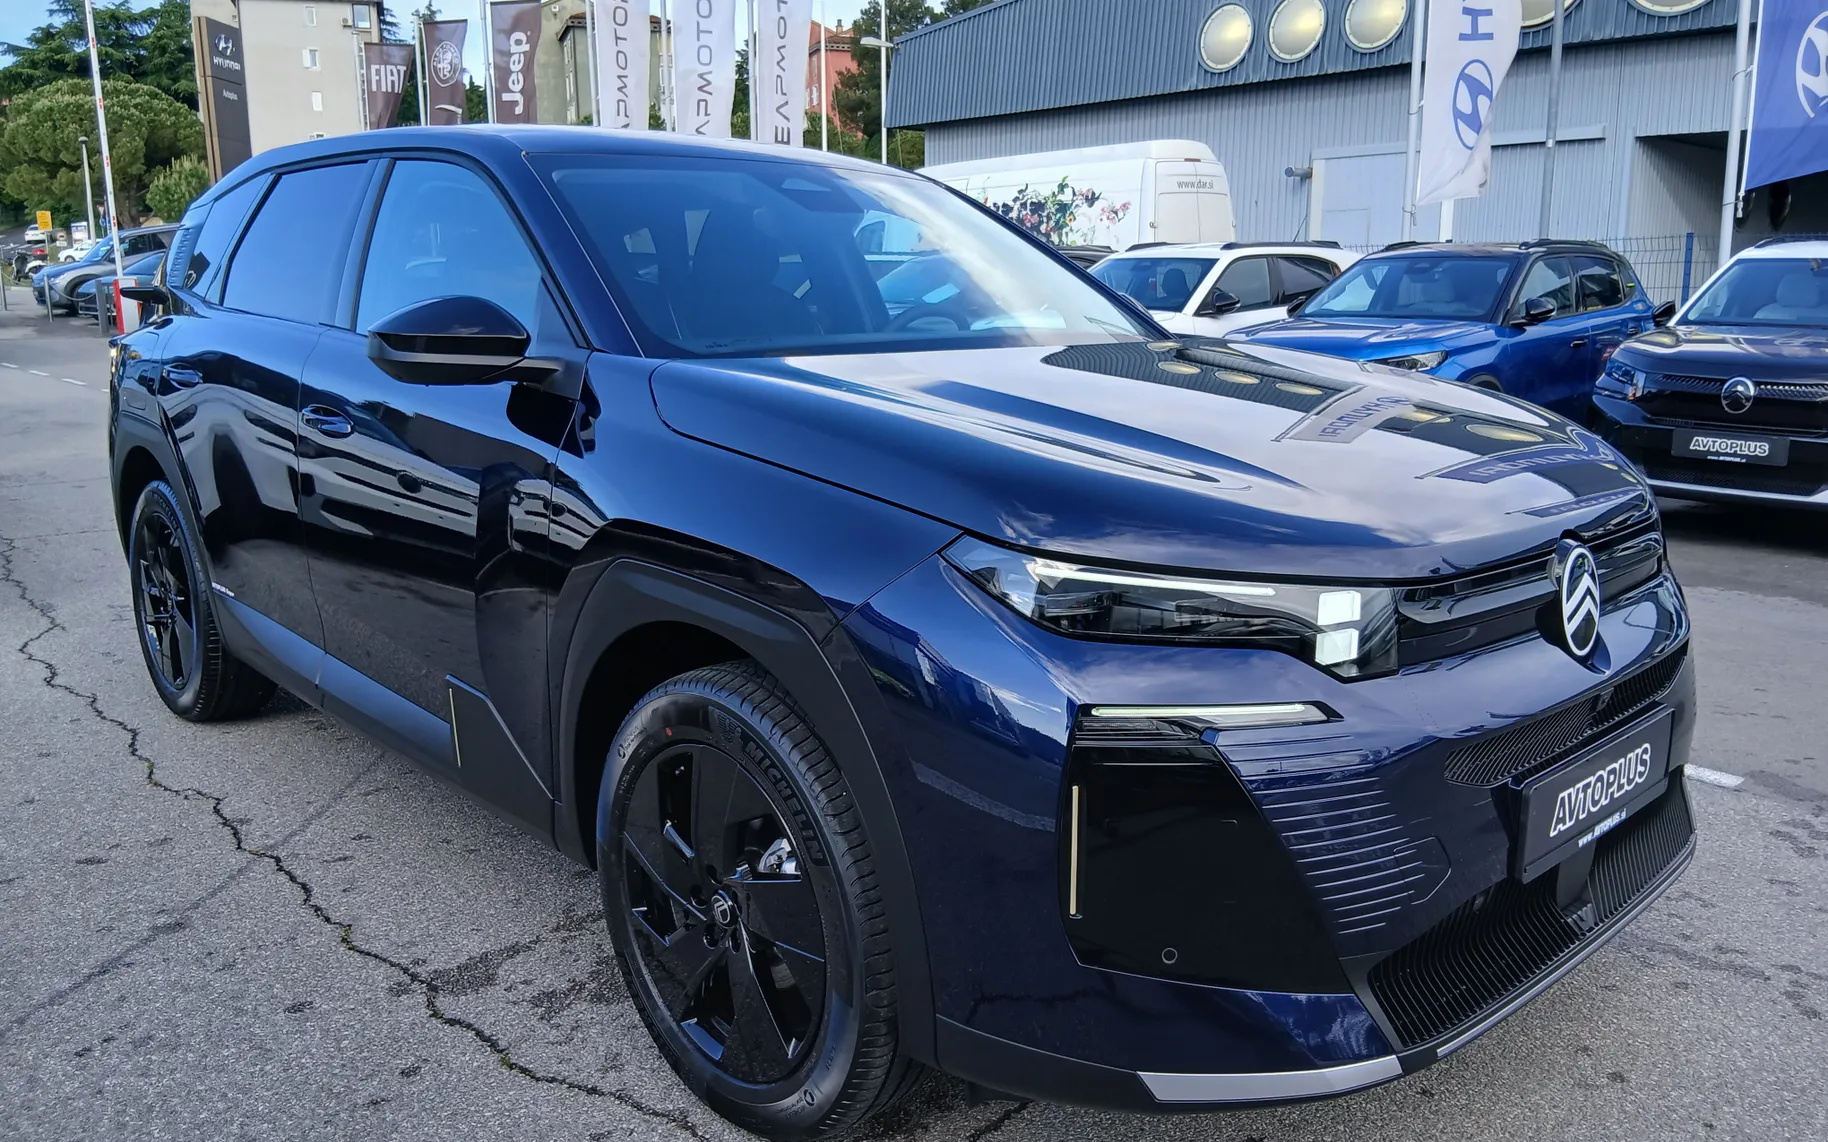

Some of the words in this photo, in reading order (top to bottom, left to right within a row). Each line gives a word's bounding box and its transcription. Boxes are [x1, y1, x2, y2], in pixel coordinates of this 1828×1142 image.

[213, 56, 241, 71] HYUNDAI
[370, 64, 407, 94] FIAT
[501, 31, 530, 115] Jeep
[613, 0, 630, 128] PMOTO
[1176, 178, 1214, 190] www.dar.si
[1690, 436, 1769, 456] AVTOPLUS
[744, 741, 824, 859] MICHELIN
[1550, 743, 1651, 837] AVTOPLUS
